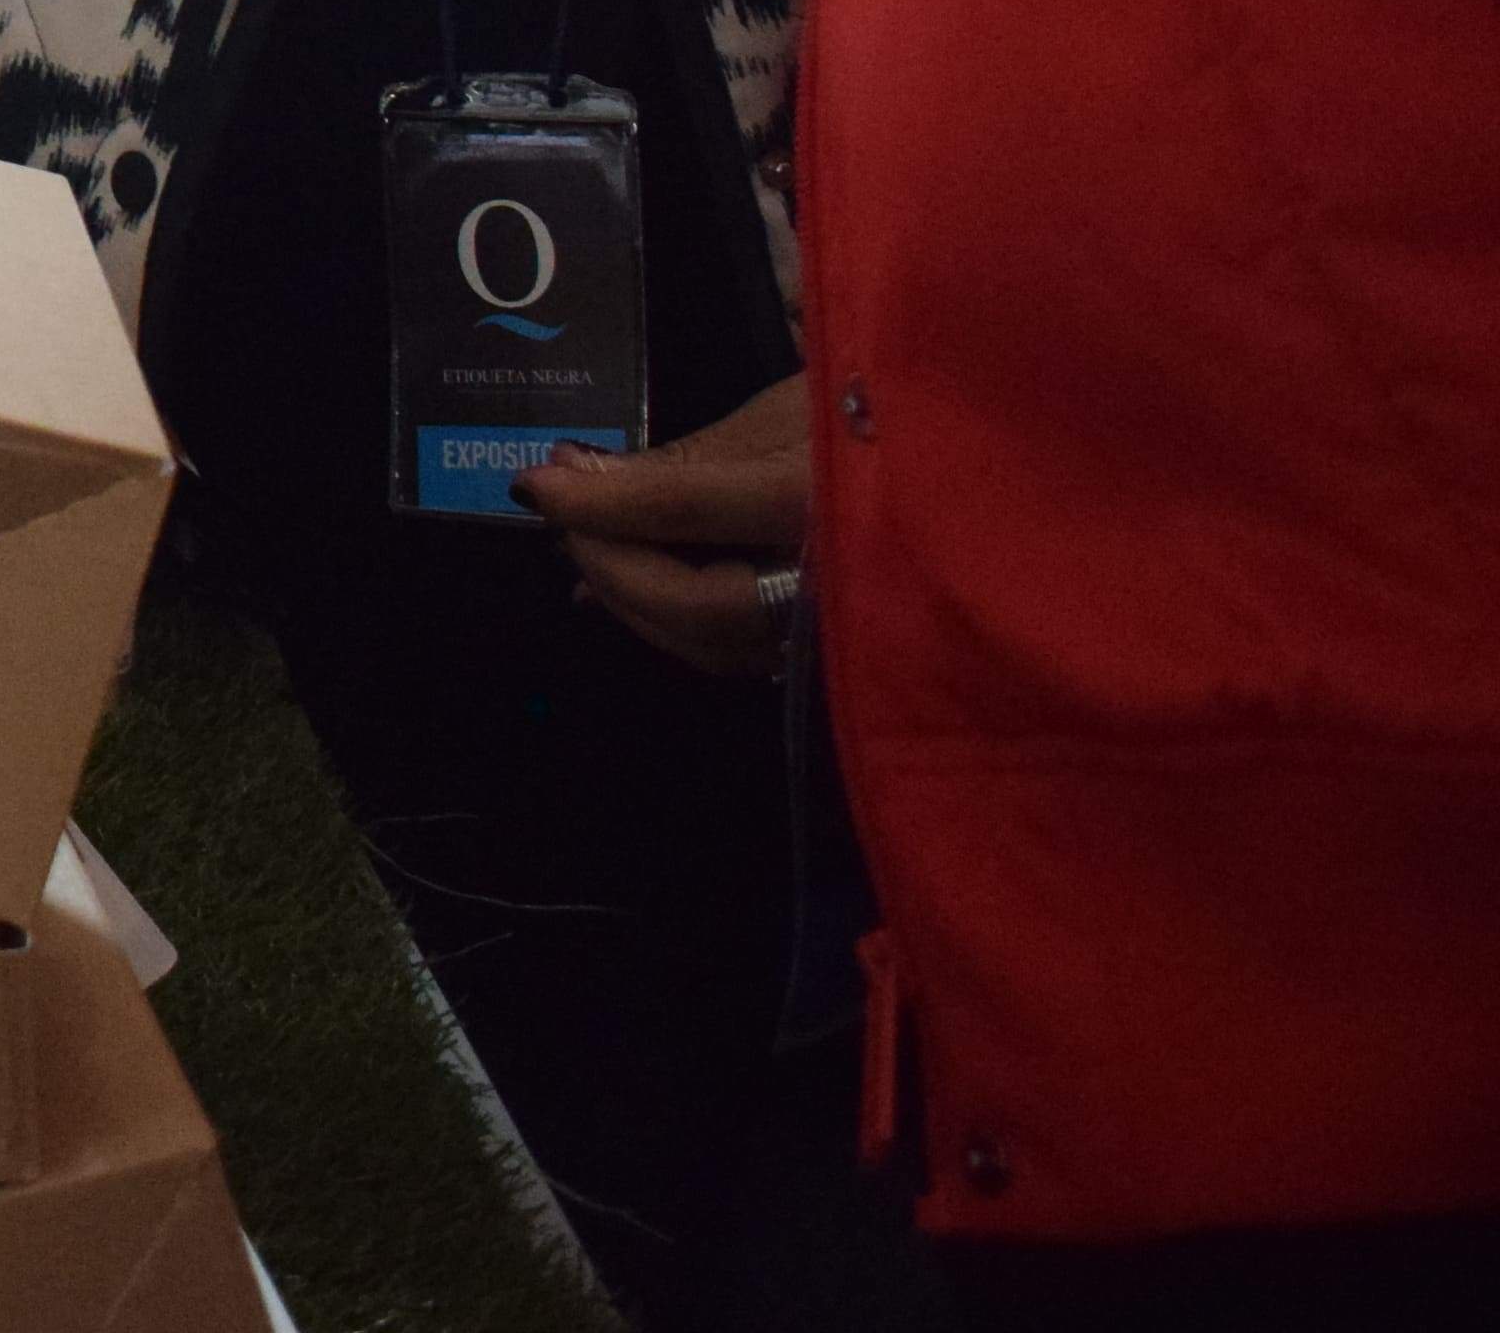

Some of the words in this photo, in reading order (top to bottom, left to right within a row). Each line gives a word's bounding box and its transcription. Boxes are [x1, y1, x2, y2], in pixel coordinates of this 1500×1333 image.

[457, 199, 568, 341] Q
[442, 368, 527, 386] ETIQUETA
[530, 369, 595, 386] NEGRA
[442, 439, 554, 470] EXPOSITO
